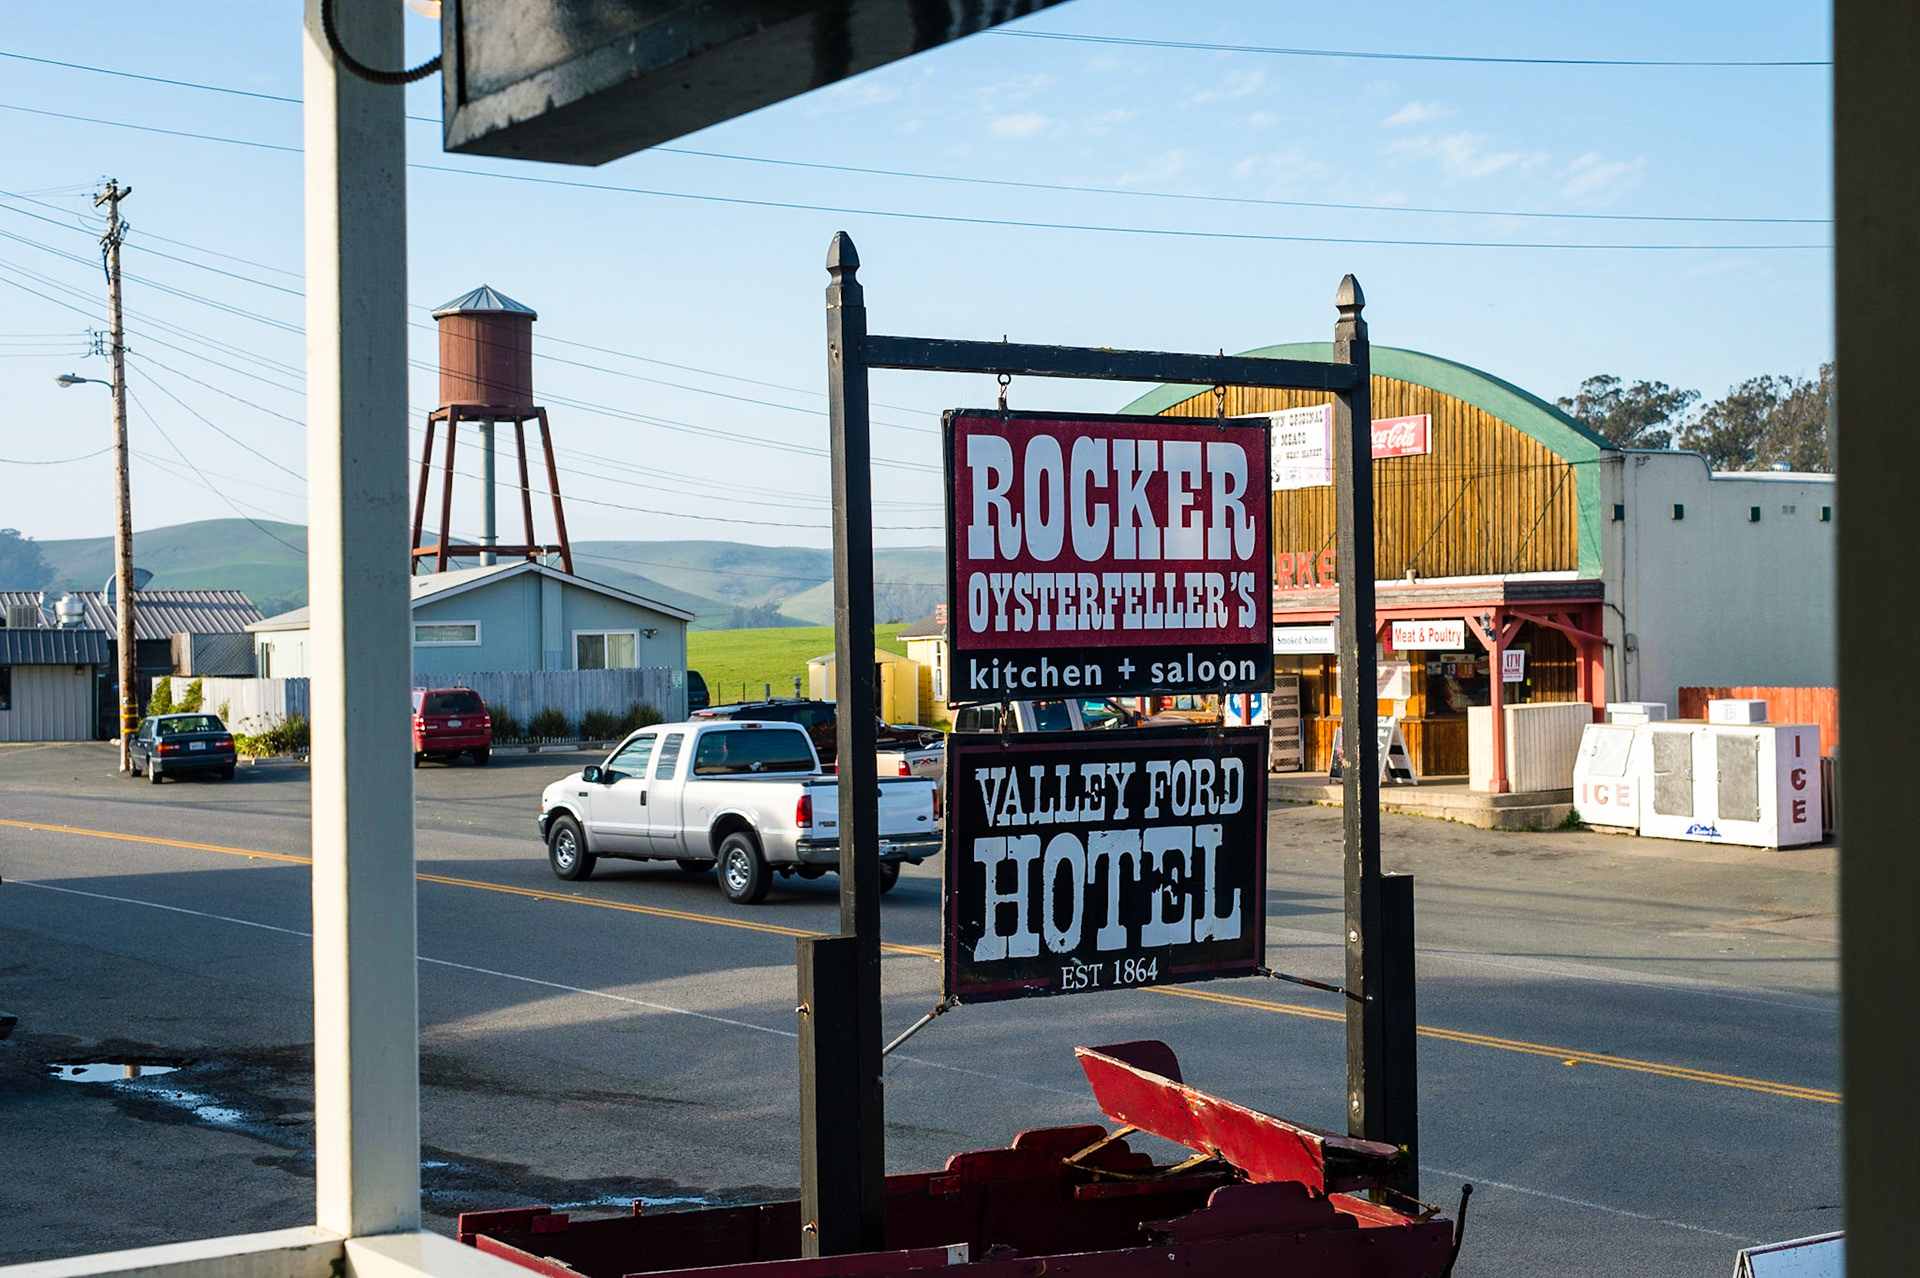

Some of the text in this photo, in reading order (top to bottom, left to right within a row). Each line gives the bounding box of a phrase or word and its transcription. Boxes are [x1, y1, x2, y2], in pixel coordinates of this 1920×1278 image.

[967, 434, 1256, 561] ROCKER
[968, 571, 1257, 633] OYSTERFELLER'S
[1277, 635, 1328, 645] Smoked Salmon
[1395, 626, 1462, 646] Meat & Poultry
[970, 657, 1102, 689] kitchen
[1151, 653, 1256, 683] saloon
[1506, 653, 1521, 668] ATM
[913, 757, 938, 766] FX4
[975, 757, 1244, 827] VALLEY FORD
[1582, 783, 1630, 807] ICE
[1790, 735, 1807, 823] ICE
[973, 823, 1242, 962] HOTEL
[1061, 957, 1159, 990] EST 1864
